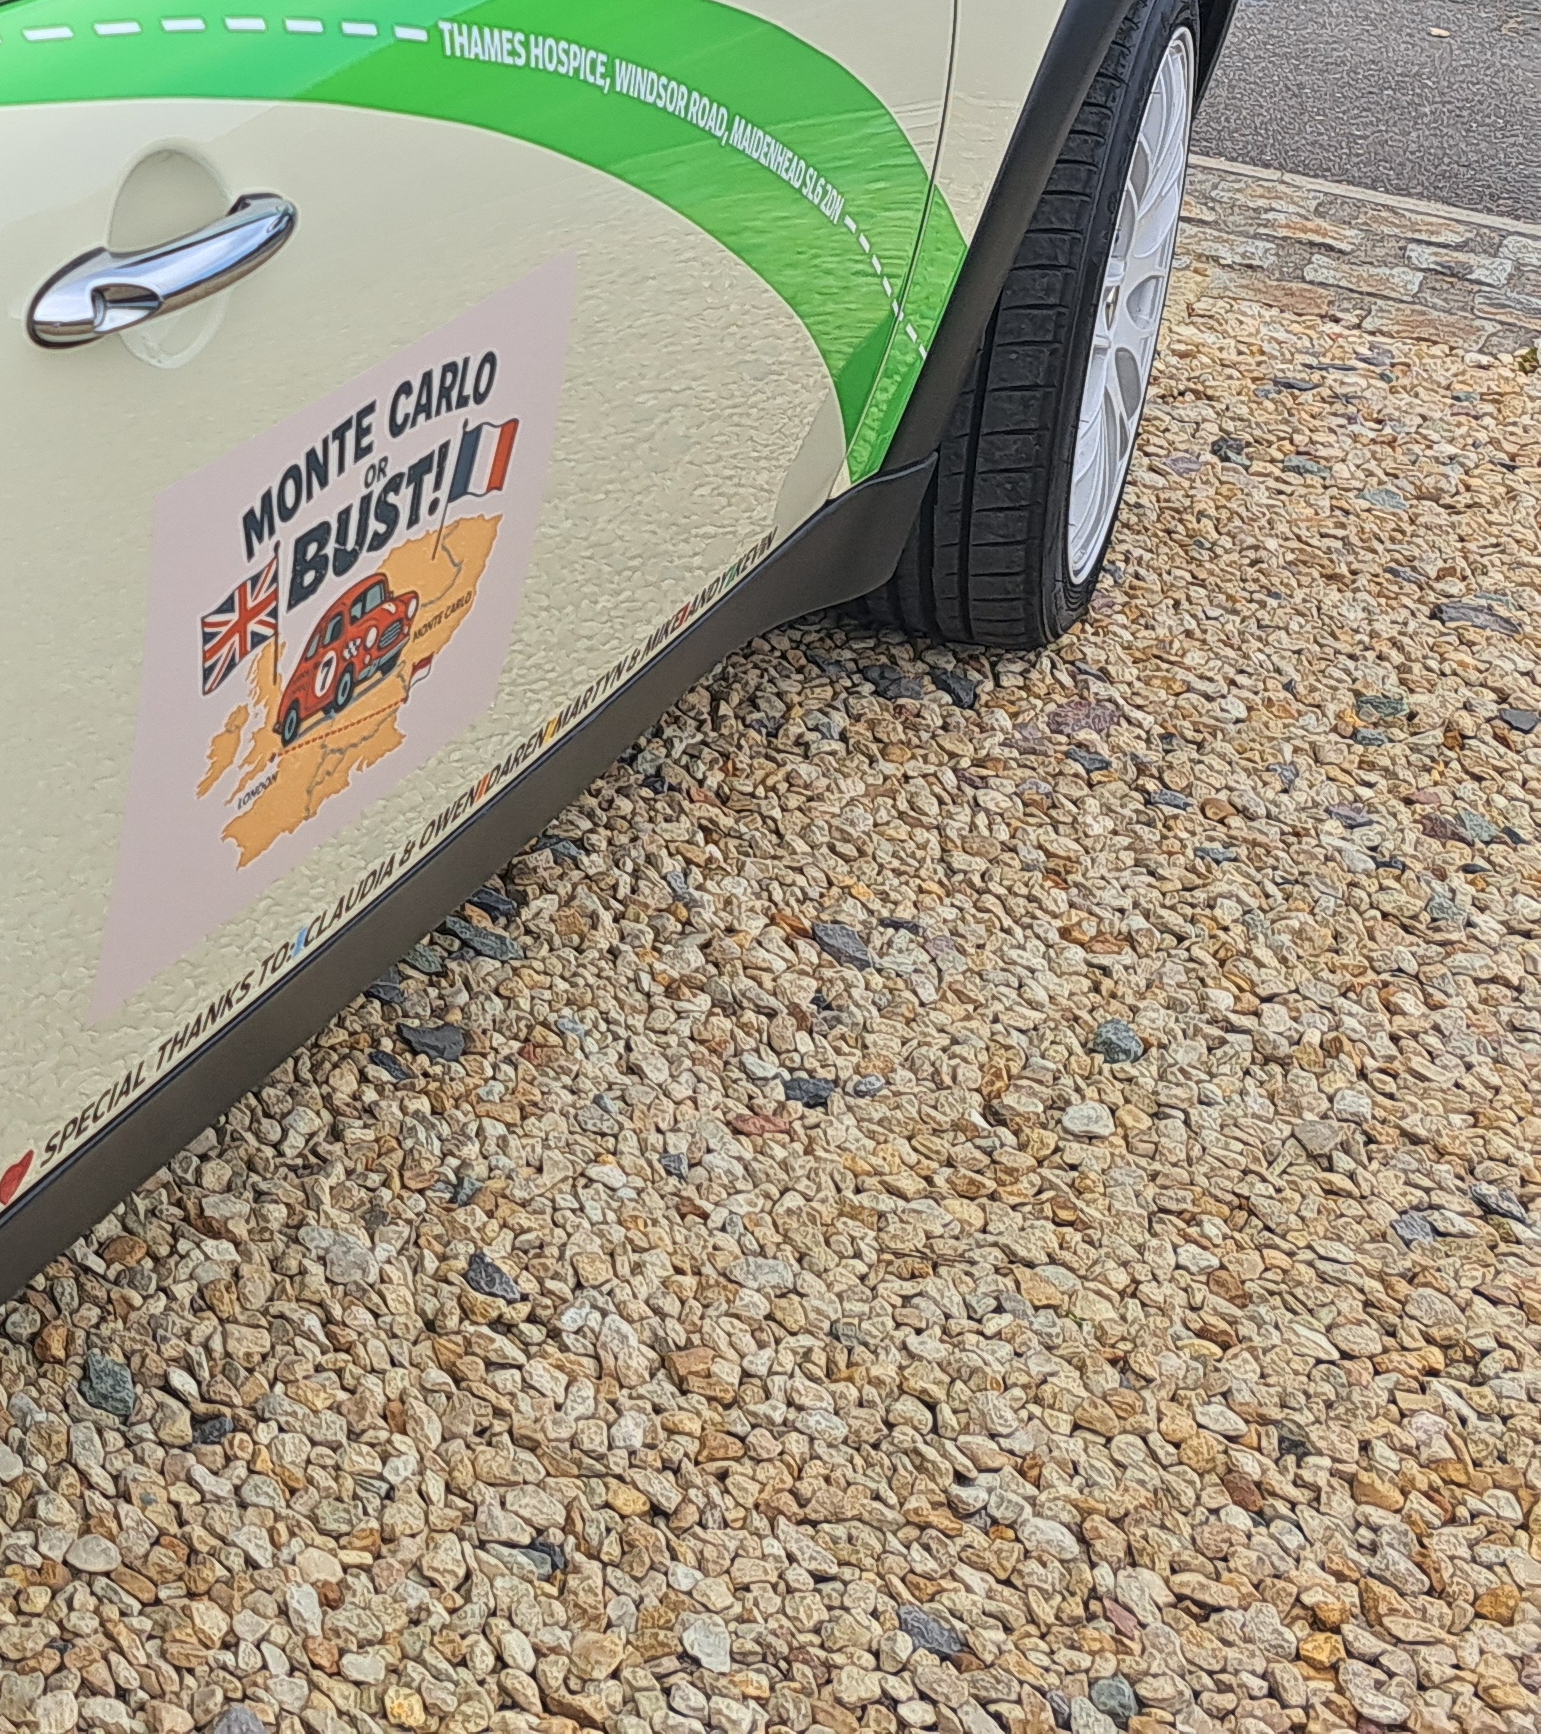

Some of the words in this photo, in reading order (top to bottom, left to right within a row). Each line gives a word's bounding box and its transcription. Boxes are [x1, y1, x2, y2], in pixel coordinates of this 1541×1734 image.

[438, 20, 527, 67] THAMES
[529, 34, 612, 94] HOSPICE,
[614, 58, 688, 122] WINDSOR
[688, 90, 729, 147] ROAD,
[729, 114, 805, 190] MAIDENHEAD
[802, 166, 827, 205] SL6
[821, 183, 845, 225] 2DN
[241, 400, 378, 562] MONTE
[388, 350, 498, 440] CARLO
[287, 440, 449, 614] BUST!
[364, 457, 388, 489] OR
[40, 1060, 146, 1168] SPECIAL
[156, 970, 255, 1072] THANKS
[259, 942, 295, 986] TO:
[304, 852, 397, 947] CLAUDIA
[399, 840, 416, 868] &
[419, 780, 481, 852] OWEN
